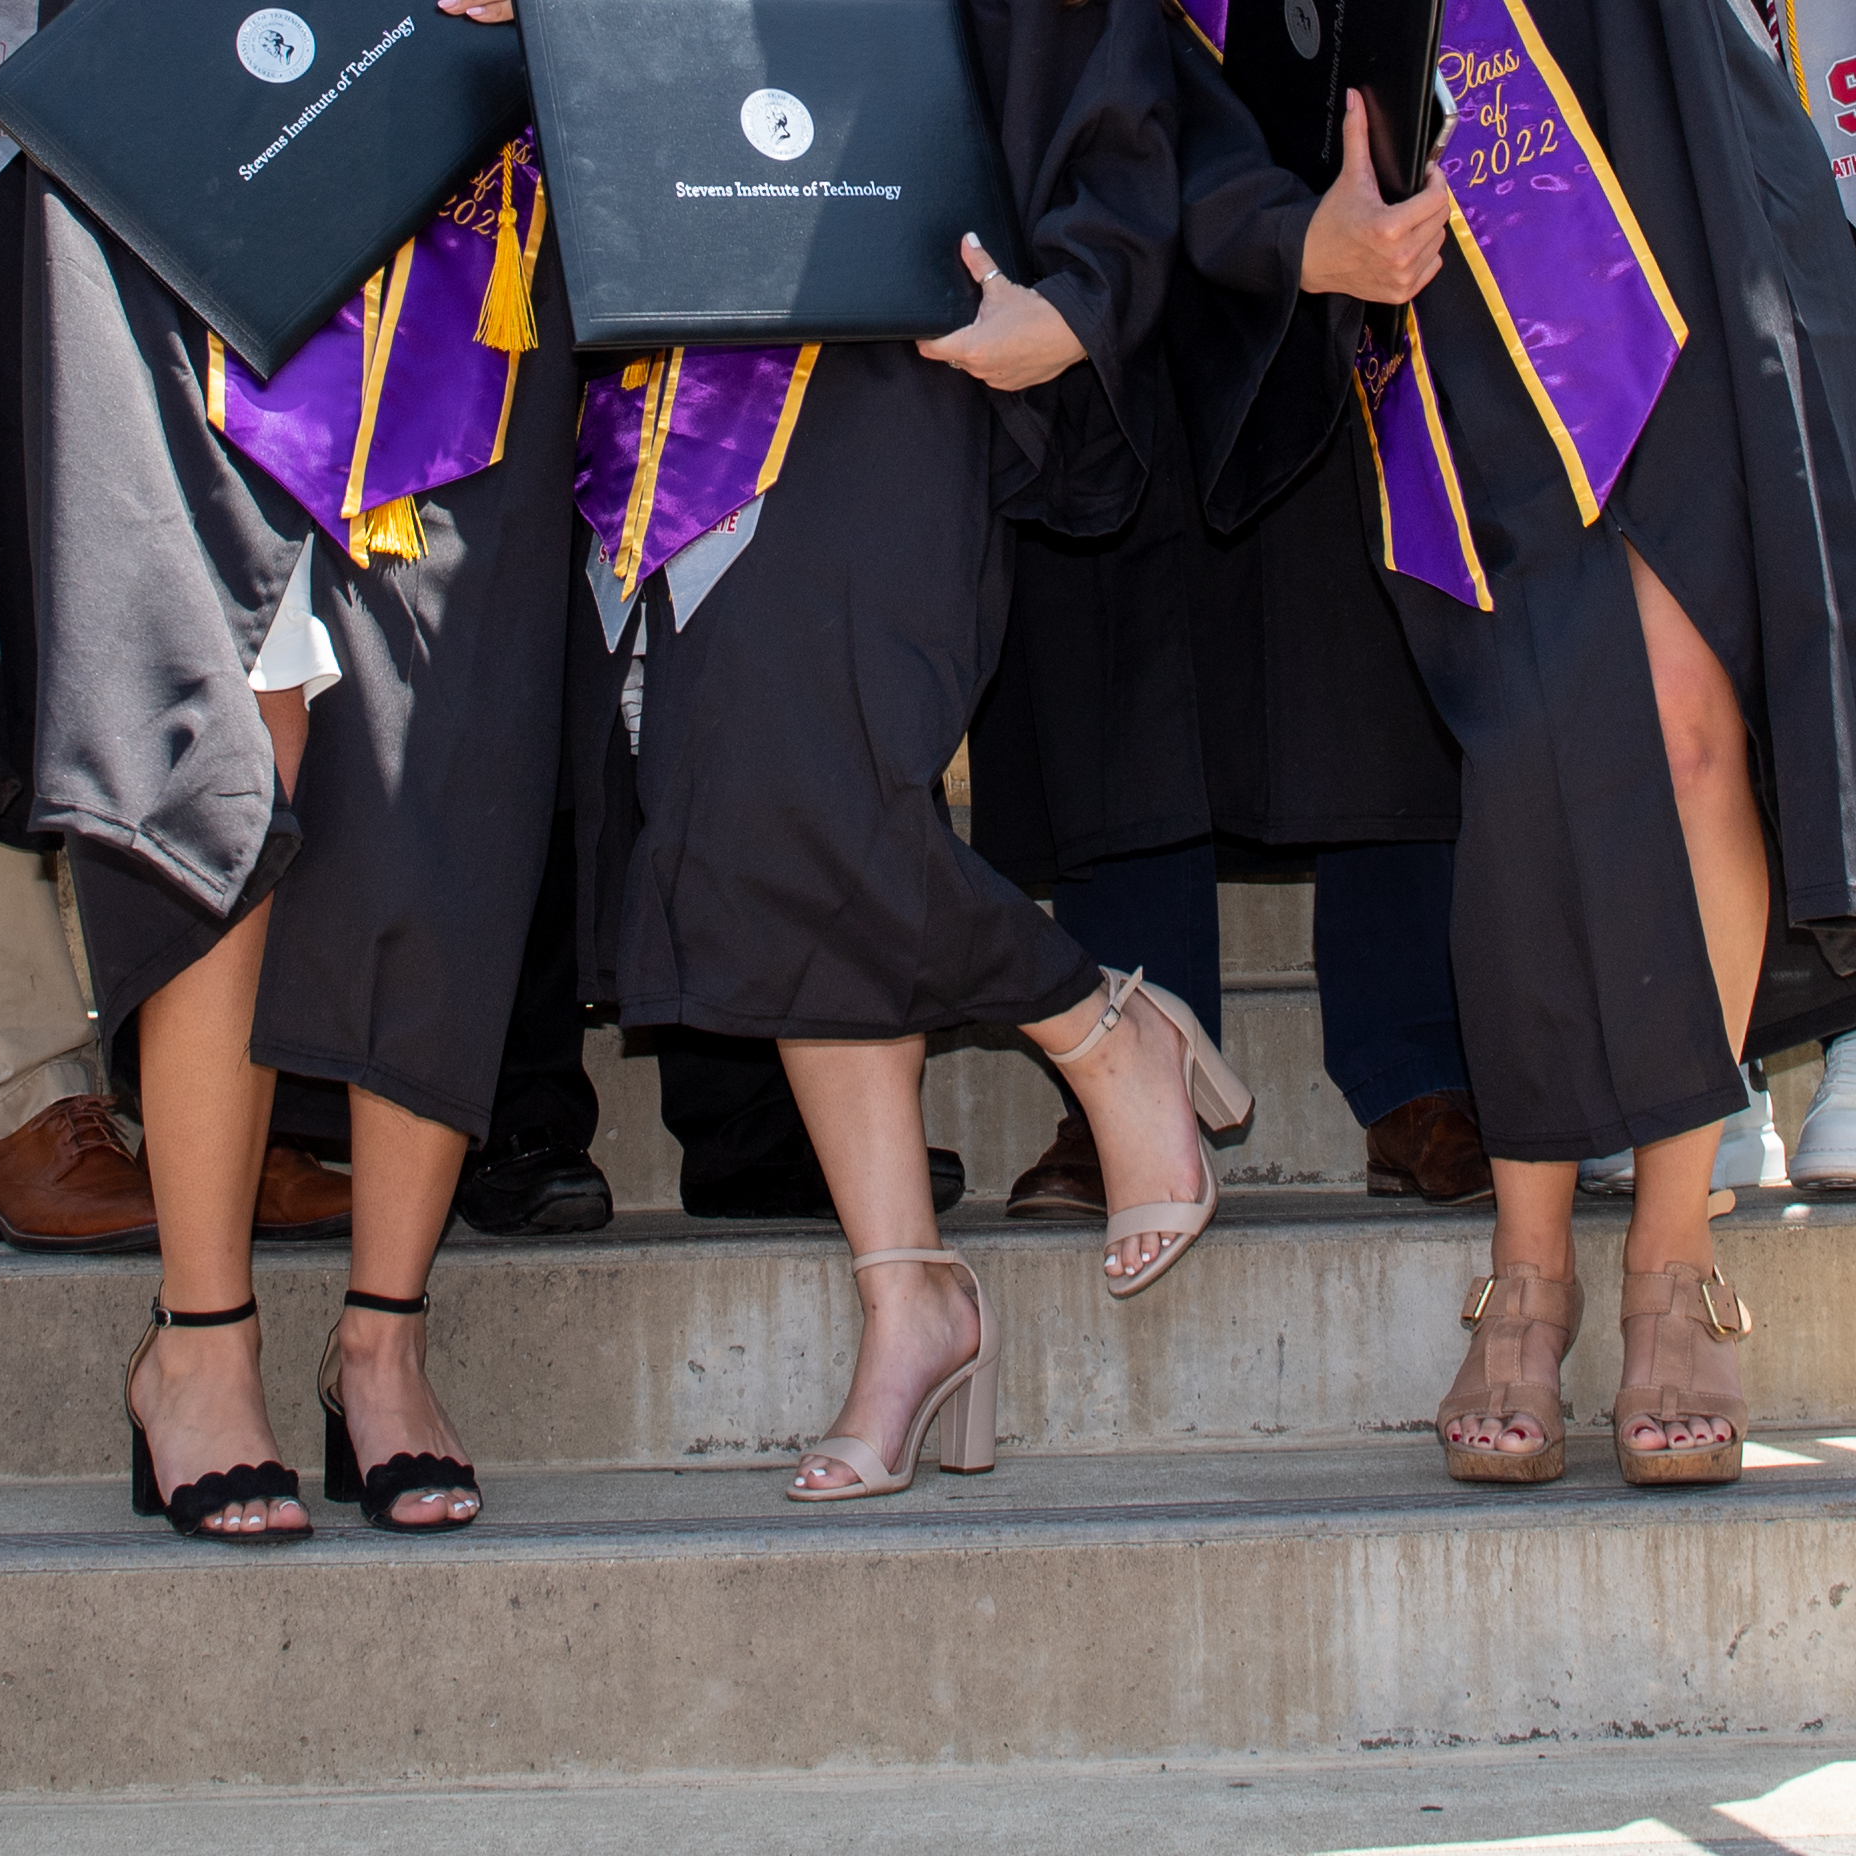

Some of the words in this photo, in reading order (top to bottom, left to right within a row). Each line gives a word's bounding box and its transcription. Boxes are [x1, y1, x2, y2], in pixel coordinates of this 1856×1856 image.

[238, 135, 289, 182] Stevens
[281, 88, 339, 139] Institute
[336, 70, 353, 92] of
[345, 15, 415, 78] Technology
[1437, 48, 1520, 102] Class
[1479, 82, 1508, 138] of
[1468, 118, 1559, 189] 2022
[675, 181, 733, 198] Stevens
[734, 181, 800, 197] Institute
[802, 180, 819, 197] of
[819, 180, 902, 200] Technology
